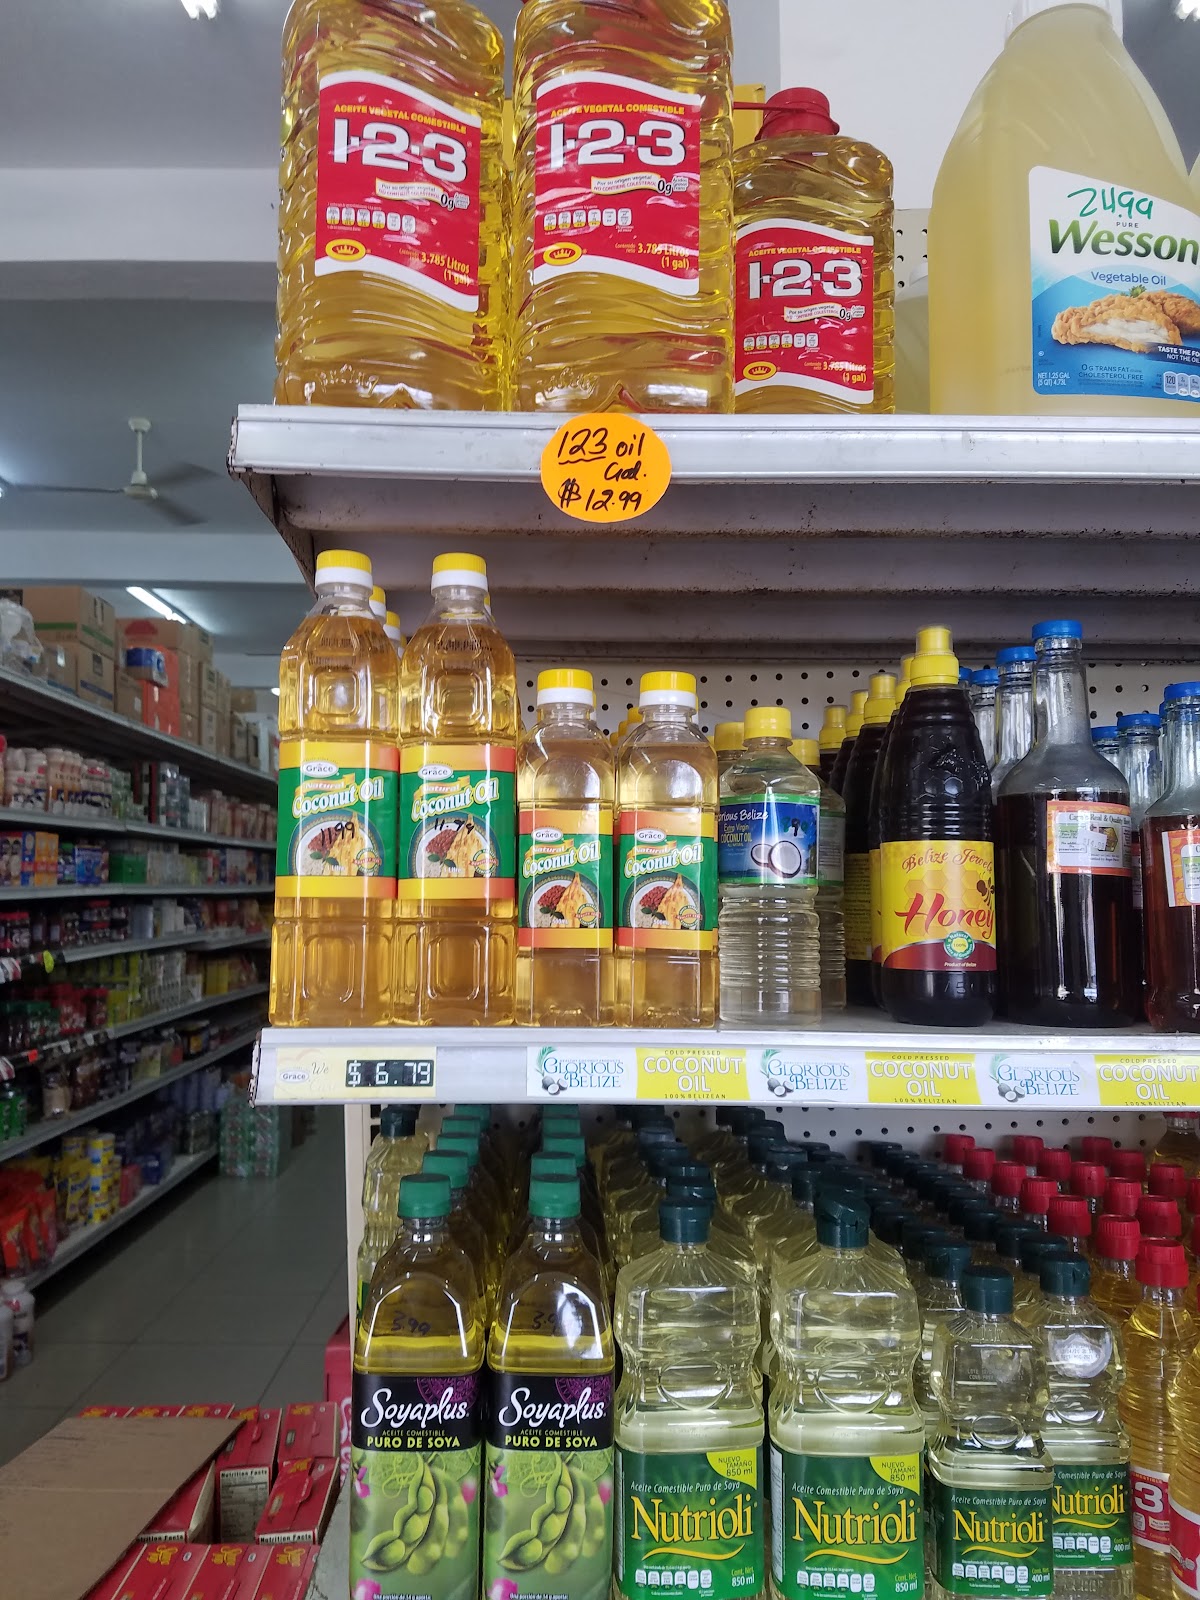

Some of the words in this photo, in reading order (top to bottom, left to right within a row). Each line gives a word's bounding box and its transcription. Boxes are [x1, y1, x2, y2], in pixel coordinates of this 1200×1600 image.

[583, 104, 625, 114] VEGETAL
[626, 104, 684, 114] COMESTIBLE
[334, 104, 367, 114] ACEITE
[370, 106, 410, 121] VEGETAL
[411, 112, 466, 134] COMESTIBLE
[1049, 219, 1200, 266] Wesson
[749, 247, 776, 258] ACEITE
[421, 252, 446, 266] 3.785
[447, 256, 470, 274] Litros
[672, 258, 690, 270] gal)
[1091, 271, 1148, 284] Vegetable
[1152, 276, 1166, 286] Oil
[852, 373, 866, 384] gal)
[558, 428, 608, 458] 123
[616, 433, 645, 457] oil
[306, 764, 334, 772] Grace
[422, 768, 448, 776] Grace
[293, 788, 358, 817] Coconut
[360, 778, 384, 799] Oil
[412, 788, 474, 820] Coconut
[475, 778, 498, 802] Oil
[740, 808, 768, 820] Belize
[536, 831, 558, 839] Grace
[720, 833, 744, 844] COCONUT
[524, 850, 577, 876] Coconut
[578, 841, 600, 862] Oil
[624, 850, 678, 877] Coconut
[682, 842, 702, 864] Oil
[902, 848, 948, 874] Belize
[952, 848, 993, 874] Jewels
[894, 892, 994, 940] Honey
[544, 1057, 624, 1076] GLORIOUS
[644, 1056, 743, 1074] COCONUT
[768, 1059, 850, 1078] GLORIOUS
[870, 1060, 972, 1080] COCONUT
[1099, 1064, 1199, 1082] COCONUT
[376, 1062, 430, 1085] 6.79
[564, 1072, 621, 1088] BELIZE
[998, 1064, 1080, 1084] GLORIOUS
[678, 1074, 712, 1092] OIL
[790, 1074, 848, 1090] BELIZE
[906, 1080, 942, 1097] OIL
[1020, 1079, 1080, 1096] BELIZE
[1136, 1083, 1170, 1100] OIL
[360, 1387, 468, 1428] Soyaplus
[498, 1387, 604, 1428] Soyaplus
[366, 1436, 402, 1448] PURO
[407, 1437, 422, 1448] DE
[426, 1436, 461, 1448] SOYA
[504, 1436, 540, 1448] PURO
[545, 1436, 561, 1448] DE
[565, 1436, 598, 1448] SOYA
[726, 1460, 752, 1468] TAMAÑO
[726, 1468, 742, 1476] 850
[744, 1467, 753, 1475] ml
[890, 1466, 916, 1474] TAMAÑO
[890, 1474, 906, 1482] 850
[1058, 1472, 1090, 1480] Comestible
[1092, 1472, 1104, 1480] Puro
[1106, 1471, 1113, 1479] de
[630, 1481, 652, 1492] Aceite
[654, 1482, 694, 1494] Comestible
[696, 1482, 712, 1492] Puro
[713, 1482, 722, 1490] de
[724, 1481, 740, 1492] Soya
[792, 1482, 814, 1494] Aceite
[816, 1486, 856, 1496] Comestible
[858, 1486, 874, 1496] Puro
[876, 1486, 886, 1495] de
[888, 1486, 904, 1496] Soya
[951, 1494, 971, 1505] Aceite
[972, 1496, 1006, 1506] Comestible
[1008, 1498, 1022, 1506] Puro
[1024, 1497, 1032, 1506] de
[1034, 1496, 1046, 1506] Soya
[630, 1493, 754, 1542] Nutrioli
[792, 1496, 918, 1545] Nutrioli
[952, 1510, 1045, 1544] Nutrioli
[260, 1536, 291, 1544] Nutrition
[1114, 1544, 1124, 1552] 400
[732, 1576, 746, 1587] 850
[746, 1574, 755, 1584] ml
[895, 1582, 908, 1592] 850
[910, 1580, 918, 1590] ml
